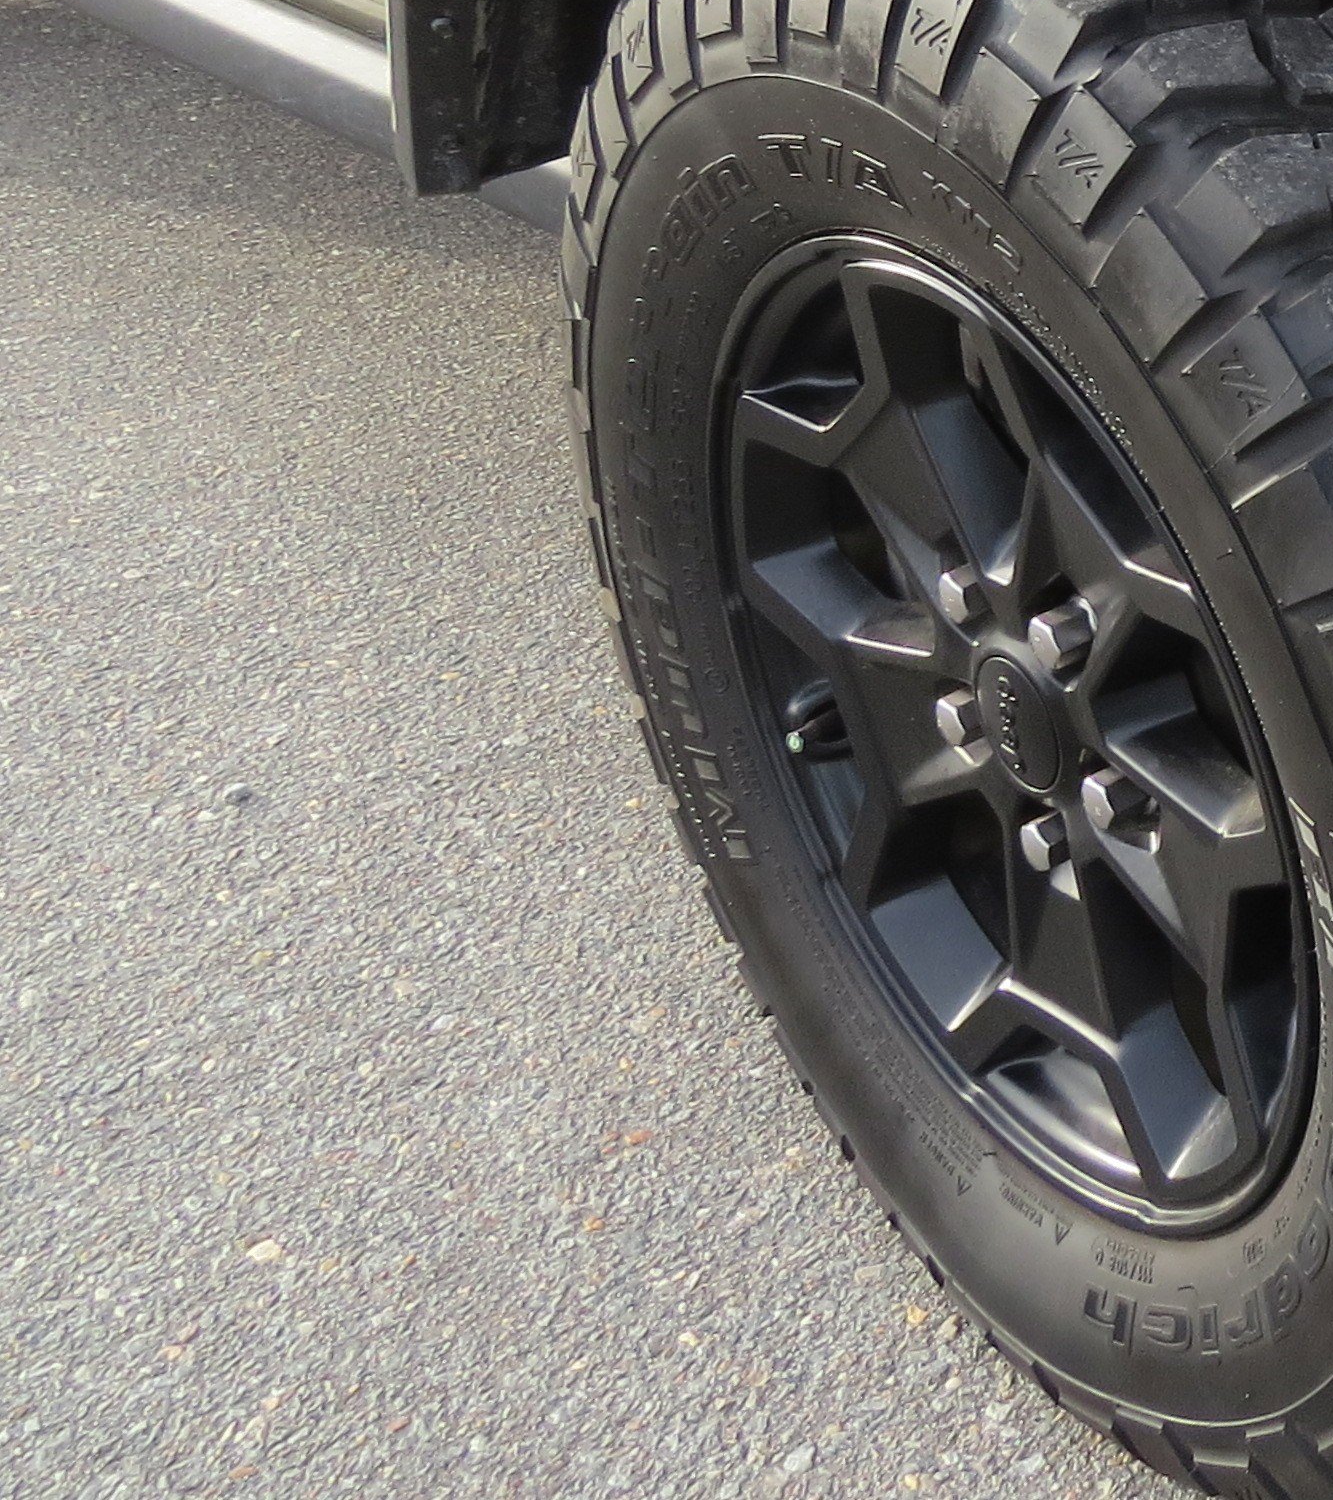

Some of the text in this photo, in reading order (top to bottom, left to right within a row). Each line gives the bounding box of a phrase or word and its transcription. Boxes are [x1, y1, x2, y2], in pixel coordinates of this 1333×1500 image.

[909, 7, 953, 57] T/A
[758, 131, 914, 217] T/A
[1054, 127, 1105, 190] T/A
